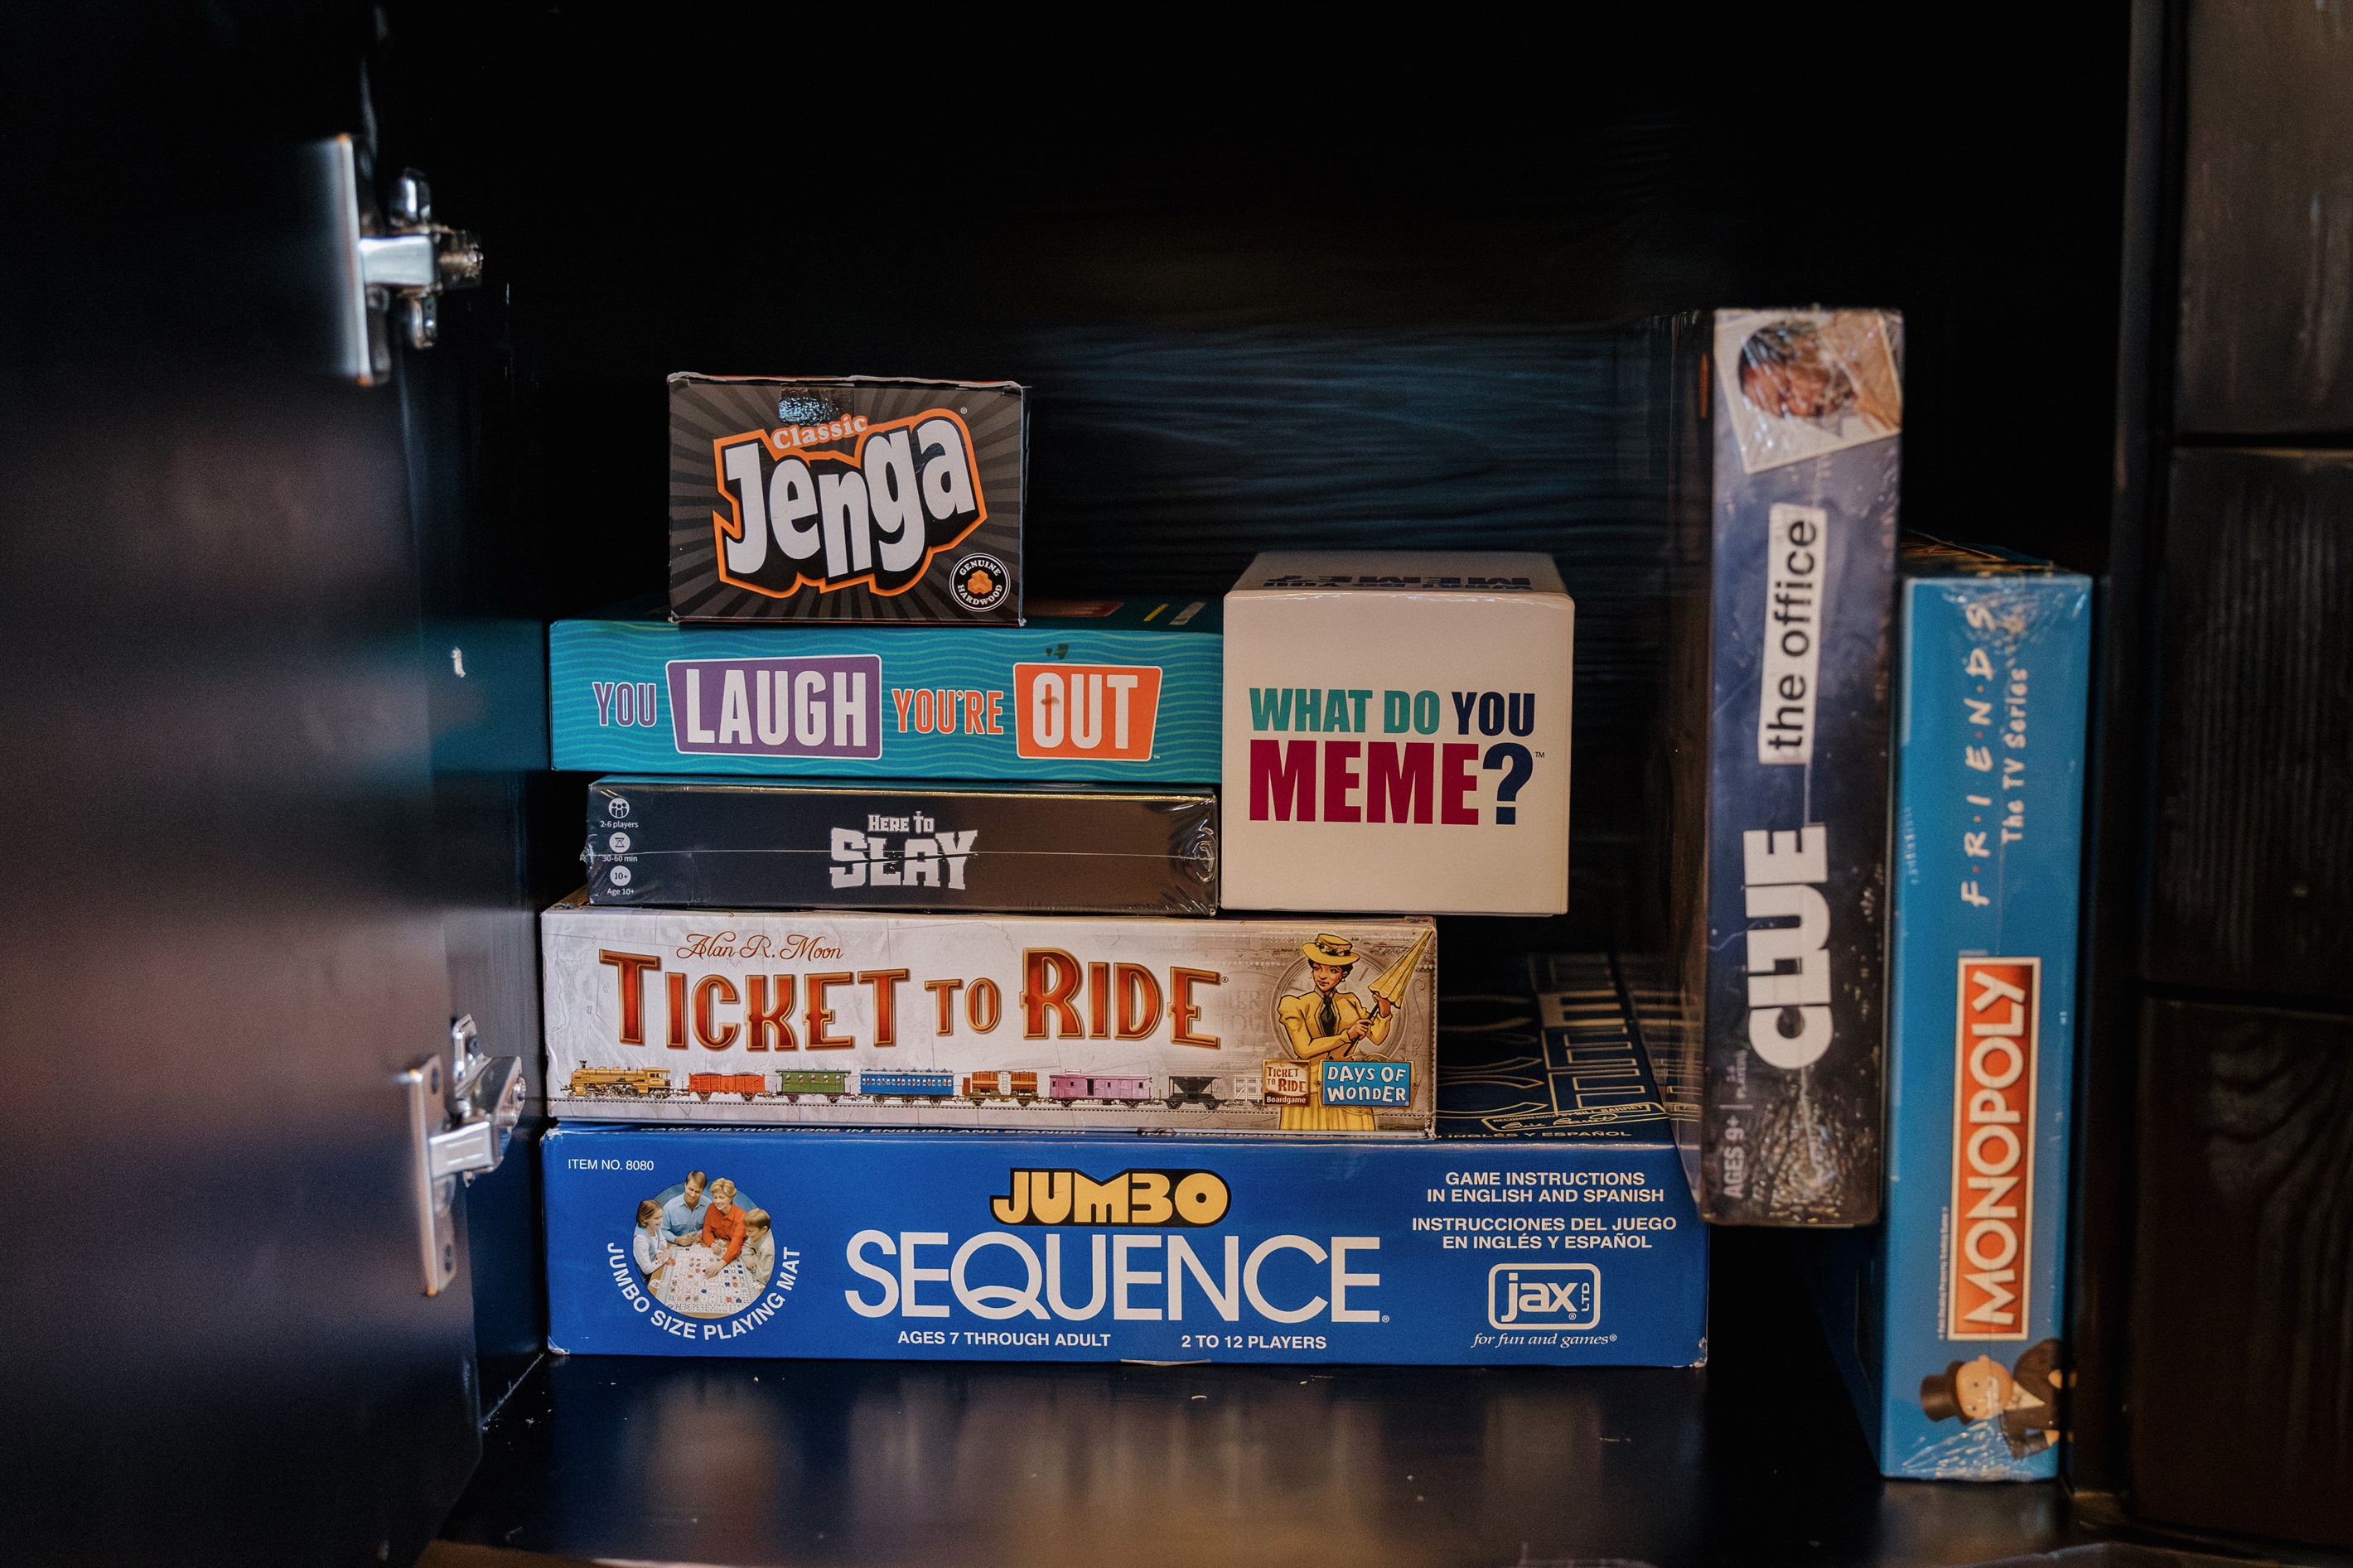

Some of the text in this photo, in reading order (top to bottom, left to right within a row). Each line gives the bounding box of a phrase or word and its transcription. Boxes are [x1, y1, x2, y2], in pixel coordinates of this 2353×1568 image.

[774, 416, 867, 450] Classic
[725, 419, 975, 578] Jenga
[959, 560, 1002, 576] GENUINE
[958, 584, 1003, 605] HARDWOOD
[1766, 519, 1817, 752] the office
[592, 681, 657, 728] YOU
[686, 668, 867, 747] LAUGH
[1033, 671, 1138, 750] OUT
[1249, 688, 1535, 737] WHAT DO YOU
[2001, 668, 2028, 844] The TV Series
[1249, 740, 1534, 826] MEME?
[613, 821, 639, 829] players
[867, 814, 909, 832] HERE
[829, 827, 978, 890] SLAY
[676, 930, 843, 961] Alan R. Moon
[1743, 826, 1834, 1069] CLUE
[599, 948, 909, 1053] TICKET
[925, 977, 1002, 1035] TO
[1020, 947, 1221, 1050] RIDE
[1267, 1066, 1299, 1078] TICKET
[1327, 1065, 1407, 1083] DAYS OF
[1278, 1078, 1307, 1093] RIDE
[1326, 1085, 1407, 1102] WONDER
[1266, 1096, 1307, 1105] Boardgame
[1963, 971, 2026, 1325] MONOPOLY
[568, 1159, 655, 1170] ITEM NO. 8080
[1723, 1146, 1745, 1199] AGES
[1445, 1172, 1645, 1185] GAME INSTRUCTIONS
[993, 1170, 1230, 1225] JUMBO
[1427, 1189, 1664, 1202] IN ENGLISH AND SPANISH
[1412, 1217, 1677, 1231] INSTRUCCIONES DEL JUEGO
[1442, 1233, 1652, 1249] EN INGLÉS Y ESPAÑOL
[844, 1229, 1380, 1324] SEQUENCE
[606, 1242, 800, 1340] JUMBO SIZE PLAYING MAT
[1500, 1272, 1590, 1323] jax LTD
[897, 1330, 1111, 1347] AGES 7 THROUGH ADULT
[1181, 1334, 1327, 1350] 2 TO 12 PLAYERS
[1471, 1333, 1495, 1348] for
[1495, 1333, 1526, 1348] fun
[1528, 1333, 1558, 1344] and
